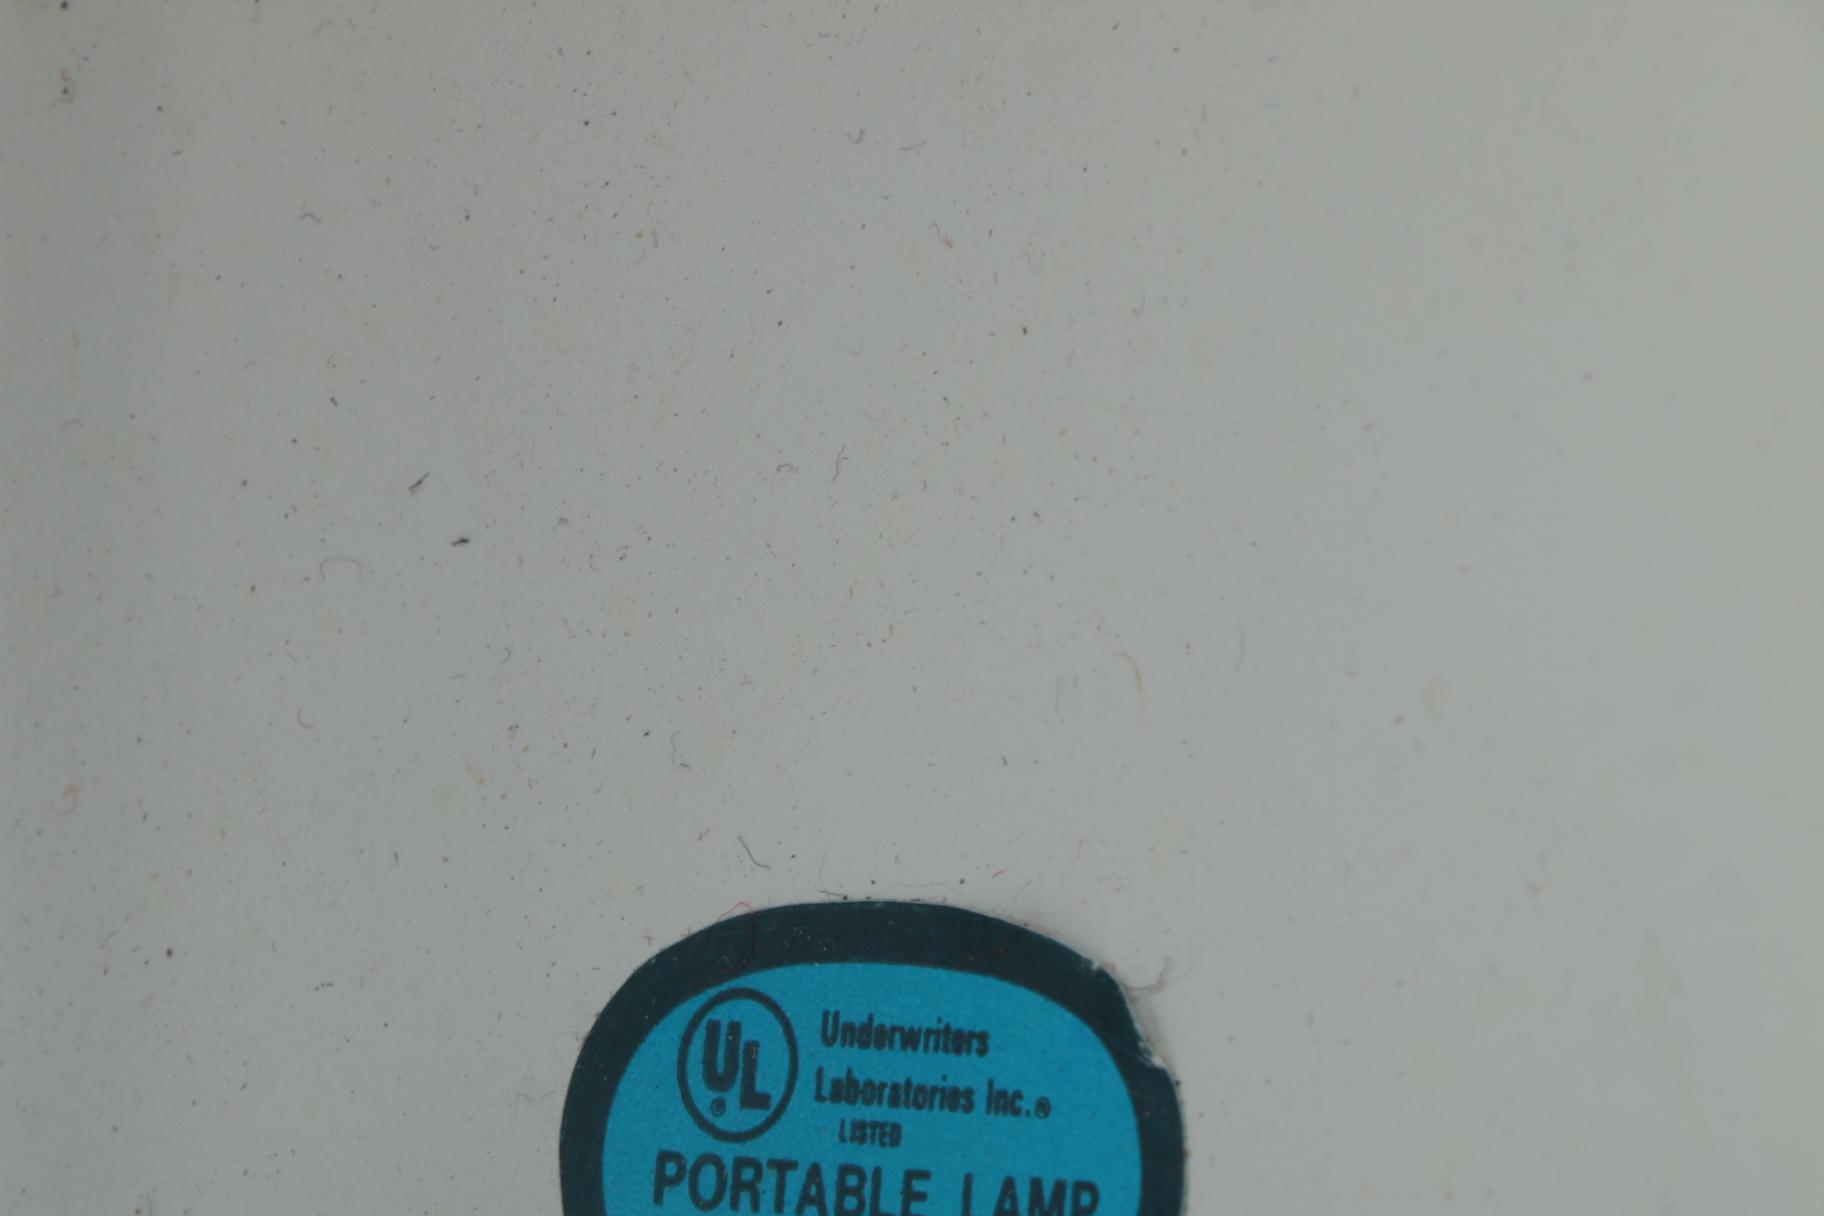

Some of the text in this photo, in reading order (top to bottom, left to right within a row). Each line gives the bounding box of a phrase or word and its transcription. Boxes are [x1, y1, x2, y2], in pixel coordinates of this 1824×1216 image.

[821, 1009, 990, 1057] Underwriters
[815, 1065, 976, 1114] Laboratories
[838, 1119, 902, 1147] LISTED
